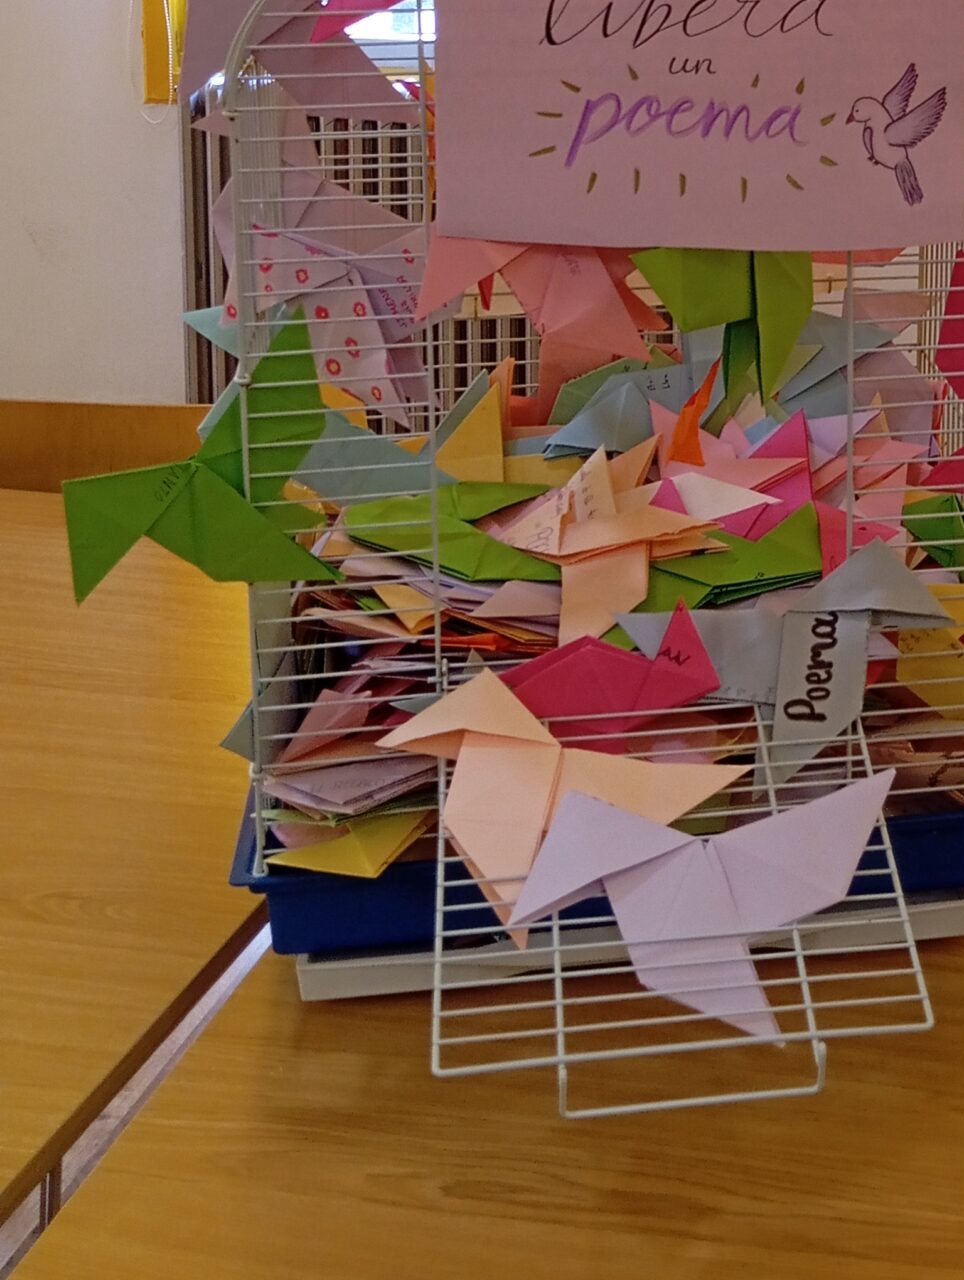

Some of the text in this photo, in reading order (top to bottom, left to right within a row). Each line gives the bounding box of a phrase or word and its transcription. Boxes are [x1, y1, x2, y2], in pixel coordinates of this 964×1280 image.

[668, 56, 717, 75] un
[564, 92, 809, 167] poema
[783, 610, 839, 722] Poema
